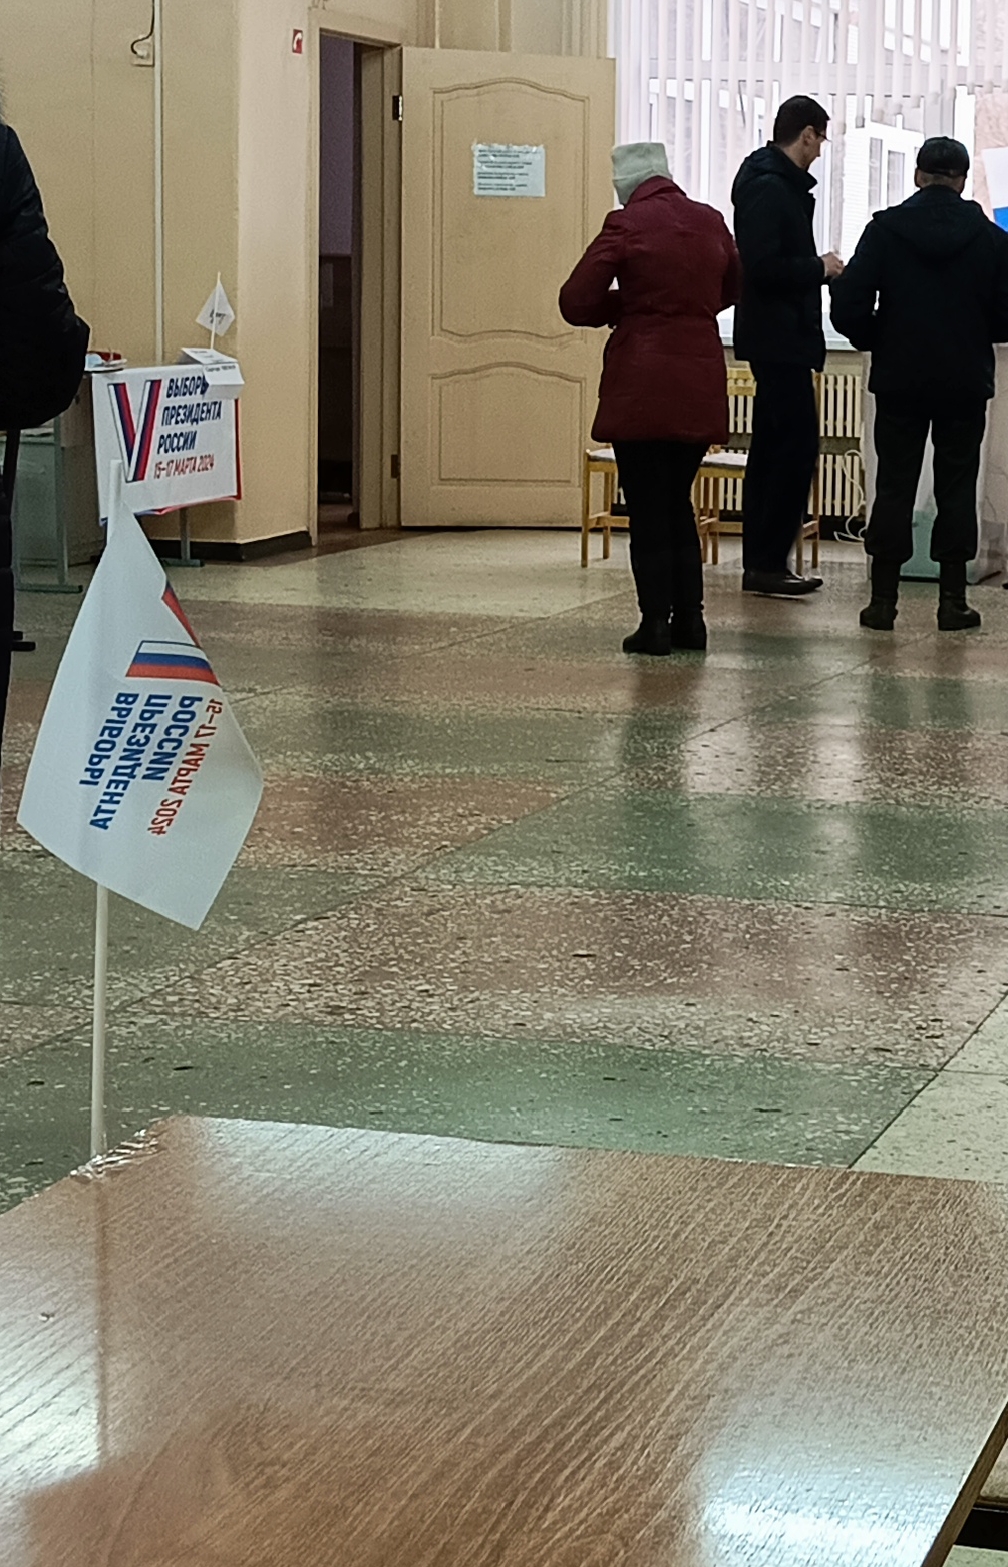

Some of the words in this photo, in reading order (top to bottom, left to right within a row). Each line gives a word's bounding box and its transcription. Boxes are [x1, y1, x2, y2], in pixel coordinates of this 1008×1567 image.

[161, 401, 222, 427] ПРЕЗИДЕНТА
[157, 431, 197, 455] РОССИИ
[173, 456, 198, 476] МАРТА
[197, 453, 215, 473] 2024
